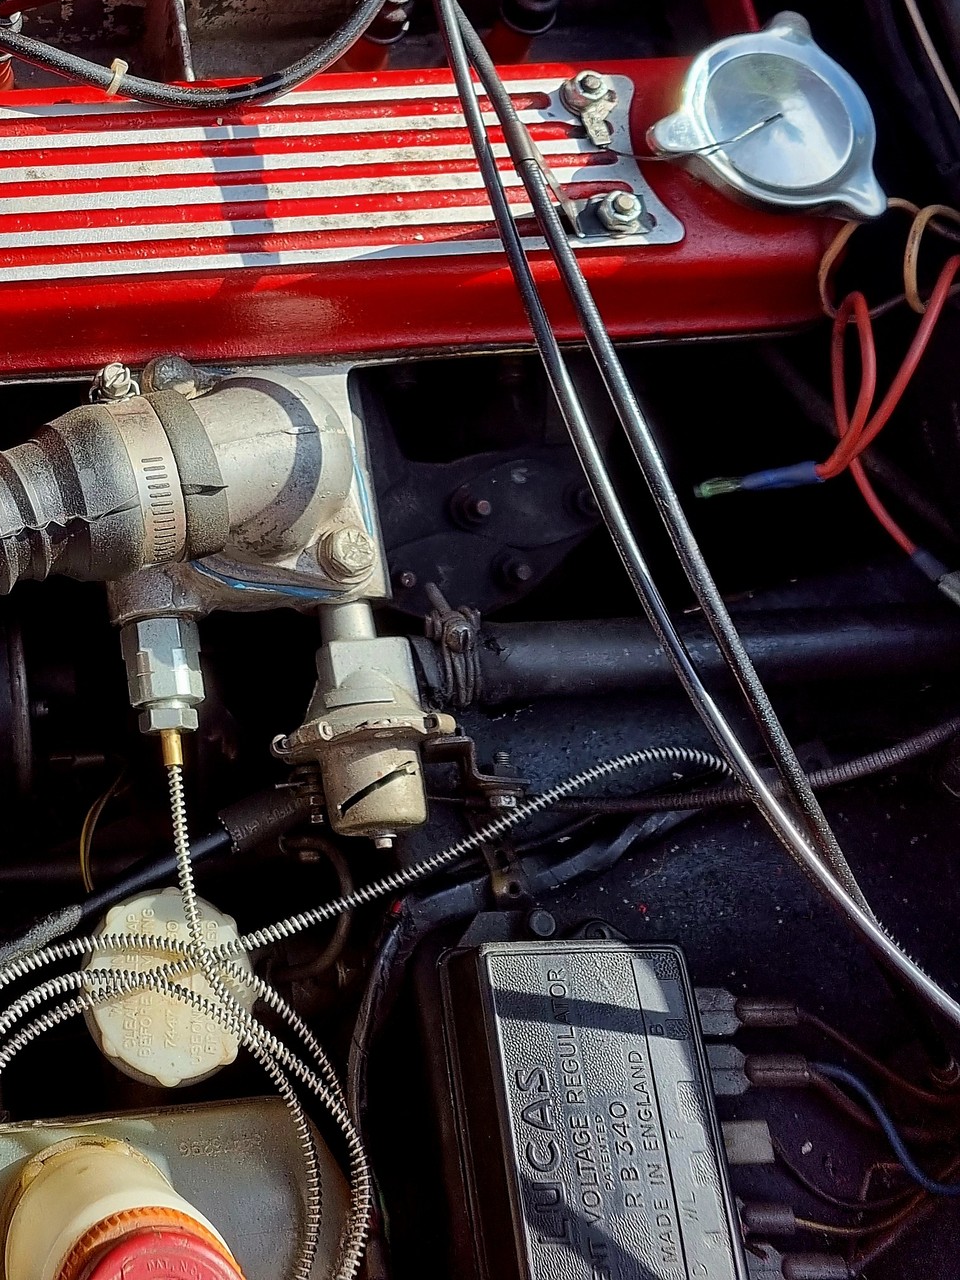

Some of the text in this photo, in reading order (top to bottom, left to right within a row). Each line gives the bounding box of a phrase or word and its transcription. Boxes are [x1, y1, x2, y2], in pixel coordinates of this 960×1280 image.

[547, 968, 587, 1106] REGULATOR
[514, 1066, 569, 1246] LUCAS
[574, 1115, 601, 1226] VOLTAGE
[594, 1113, 616, 1191] PATENTED
[627, 1050, 680, 1264] MADE IN ENGLAND
